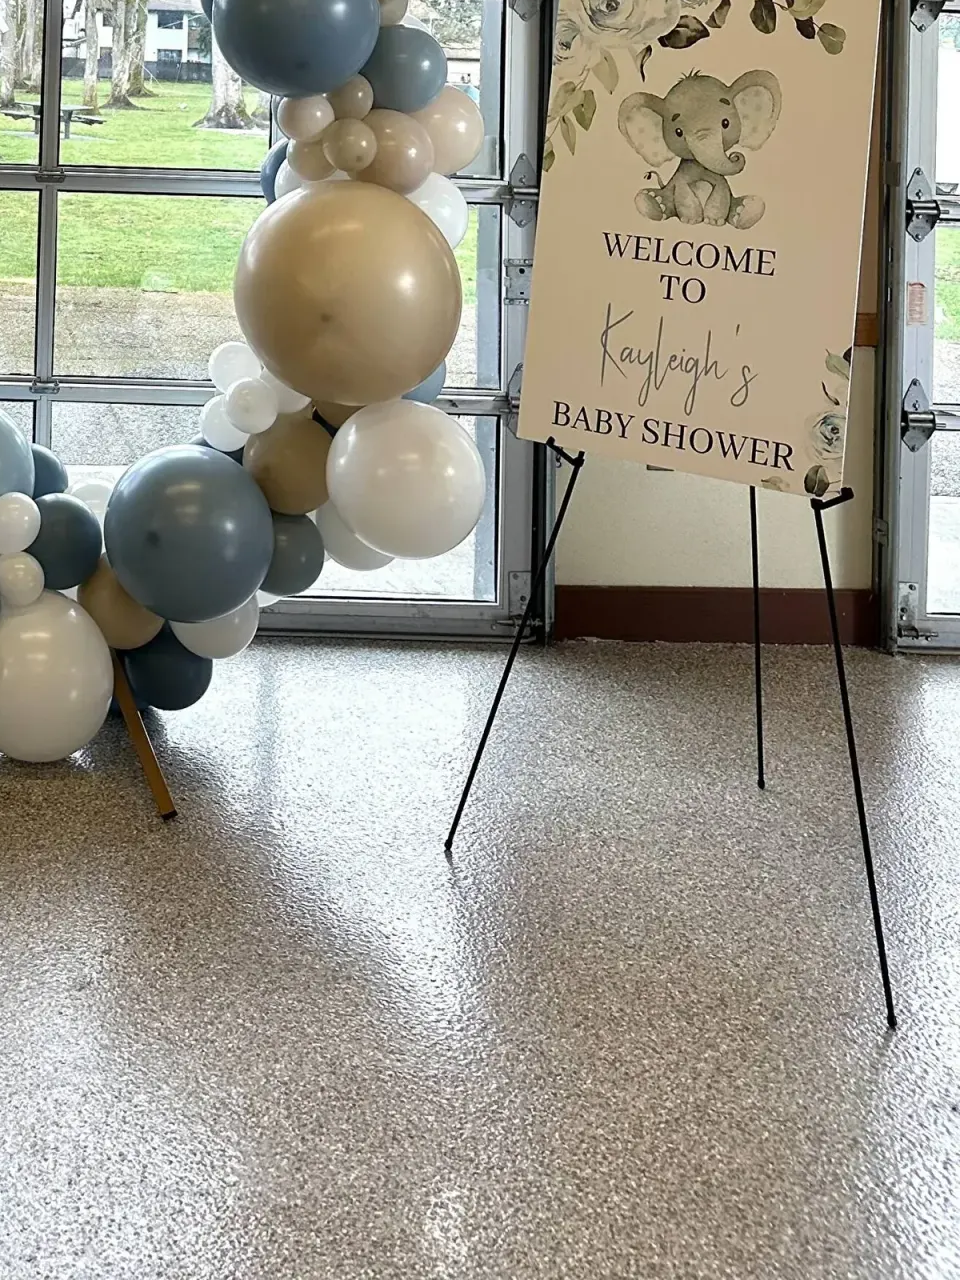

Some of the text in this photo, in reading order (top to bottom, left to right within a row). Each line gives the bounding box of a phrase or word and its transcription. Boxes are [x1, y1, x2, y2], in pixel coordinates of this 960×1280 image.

[602, 231, 778, 277] WELCOME
[659, 274, 707, 304] TO
[600, 302, 759, 417] Kayleigh's
[551, 400, 796, 472] BABY SHOWER
